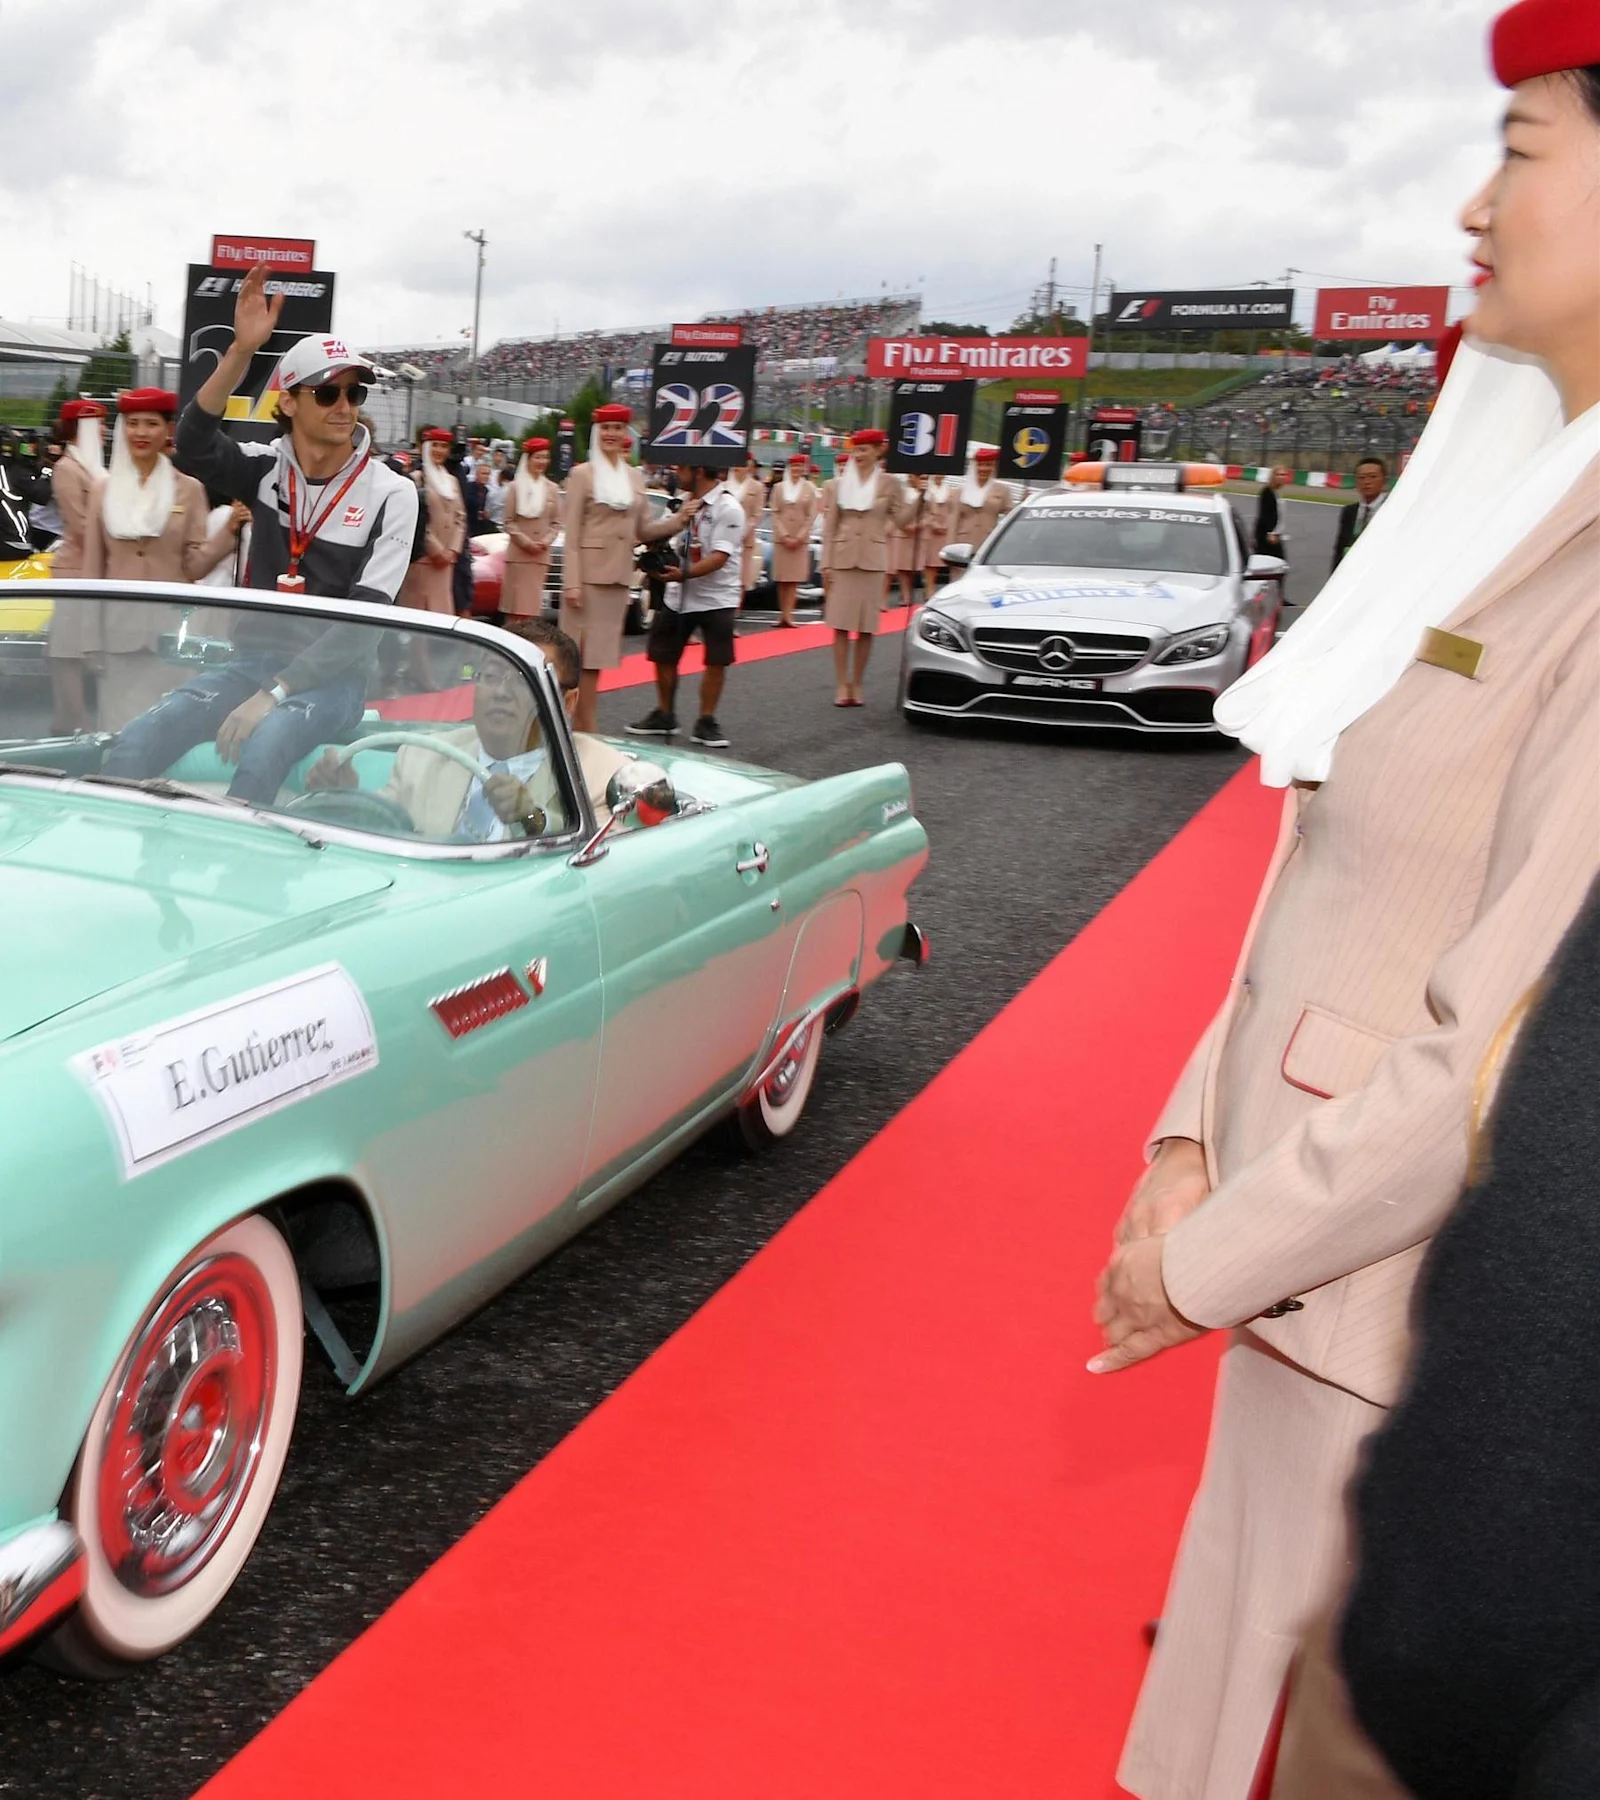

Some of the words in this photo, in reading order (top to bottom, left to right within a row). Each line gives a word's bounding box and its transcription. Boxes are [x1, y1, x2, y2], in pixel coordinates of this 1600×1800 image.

[216, 244, 243, 262] Fly
[244, 246, 310, 263] Emirates
[1368, 295, 1397, 311] Fly
[1330, 311, 1432, 330] Emirates
[883, 342, 934, 367] Fly
[939, 341, 1073, 367] Emirates
[651, 382, 747, 447] 22
[897, 411, 960, 457] 31
[1012, 426, 1052, 469] 9
[1025, 508, 1211, 524] Mercedes-Benz
[1001, 587, 1121, 606] Allianz
[1039, 677, 1097, 691] AMG
[165, 1017, 331, 1110] E.Gutierrez
